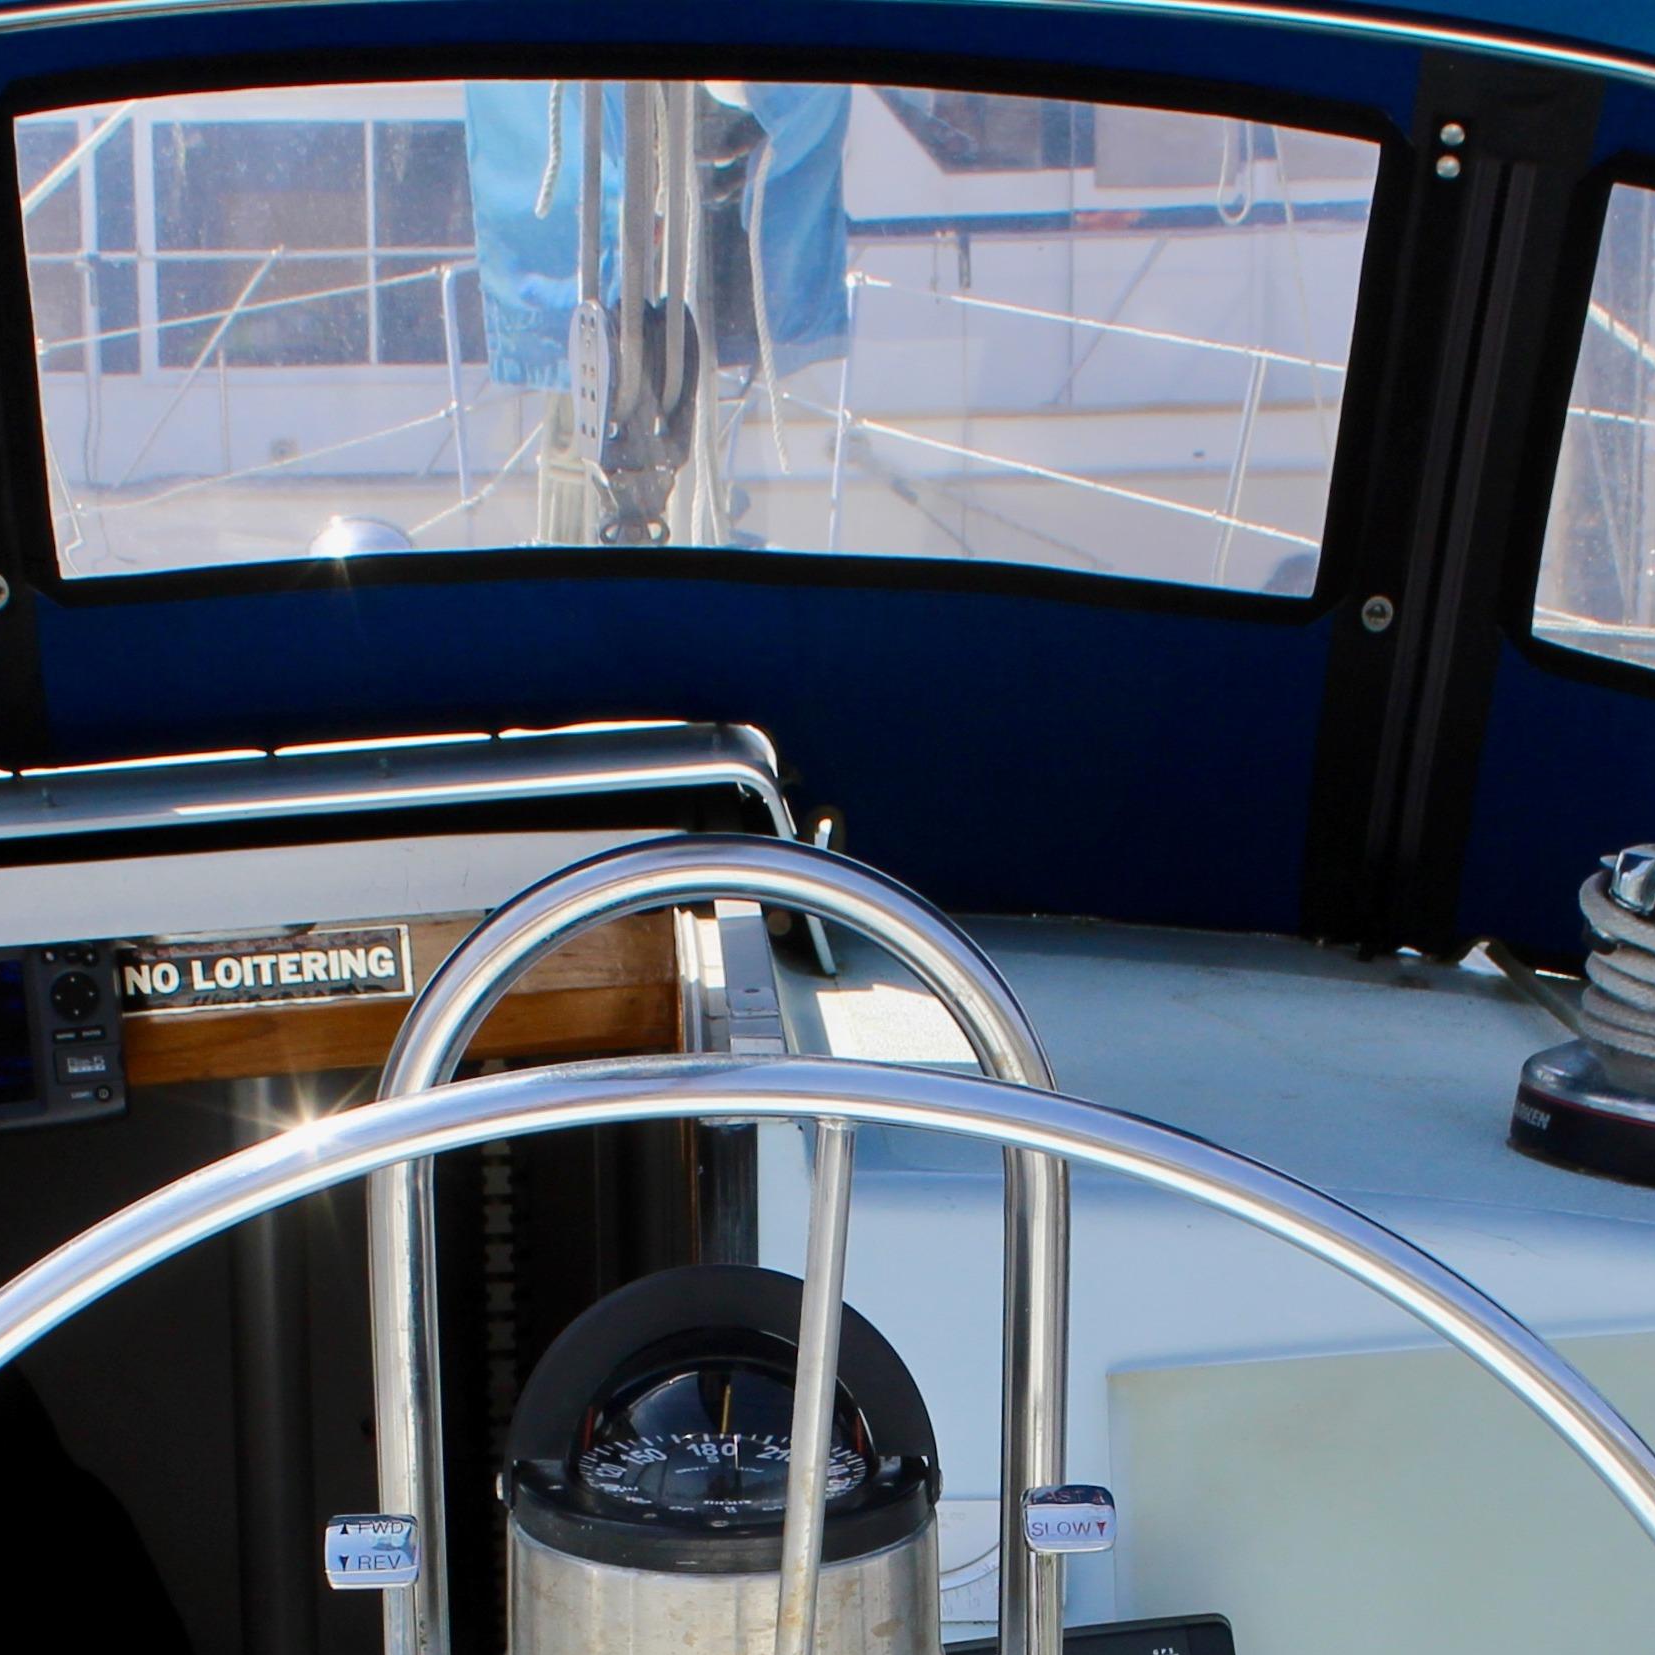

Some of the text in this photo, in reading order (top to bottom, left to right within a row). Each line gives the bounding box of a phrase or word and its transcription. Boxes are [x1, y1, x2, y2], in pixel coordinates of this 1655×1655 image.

[124, 945, 395, 995] NO LOITERING
[620, 1447, 667, 1466] 150
[687, 1442, 736, 1457] 180
[756, 1445, 791, 1462] 21
[358, 1520, 404, 1534] FWD
[1031, 1521, 1092, 1537] SLOW
[358, 1554, 401, 1570] REV
